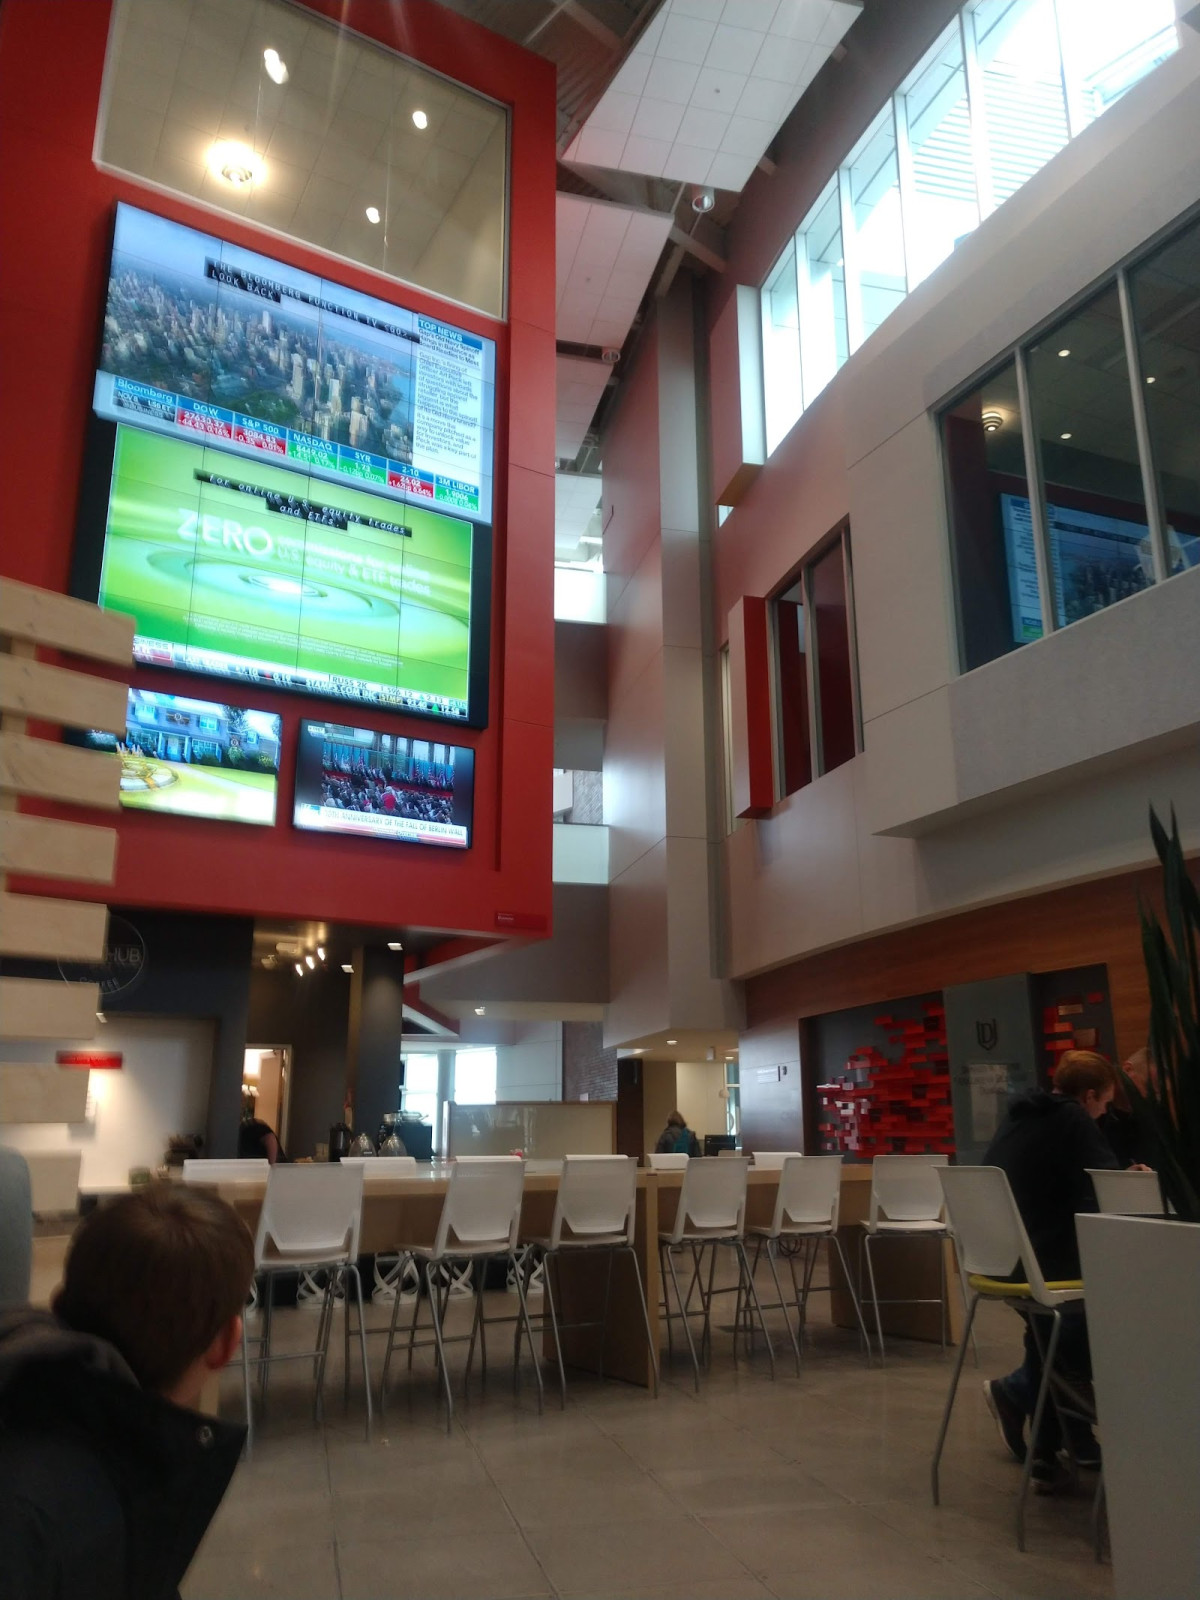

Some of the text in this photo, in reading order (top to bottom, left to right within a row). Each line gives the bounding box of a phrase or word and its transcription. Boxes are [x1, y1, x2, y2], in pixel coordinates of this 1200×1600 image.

[211, 269, 274, 301] LOOK BACK
[213, 260, 233, 274] THE
[240, 270, 301, 298] BLOOMBERG
[308, 295, 360, 321] FUNCTION
[366, 316, 378, 327] TV
[419, 320, 462, 341] TOP NEWS
[117, 379, 173, 403] Bloomberg
[193, 402, 218, 416] DOW
[242, 418, 278, 434] S&P 500
[243, 429, 276, 443] 3084.83
[293, 433, 332, 450] NASDAQ
[402, 466, 418, 476] 2-10
[439, 477, 474, 493] 3M LIBOR
[209, 473, 405, 535] for online U.S. equity trades
[279, 504, 340, 527] and ETFs.
[177, 507, 273, 556] ZERO
[332, 675, 353, 687] RUSS
[356, 681, 368, 690] 2K
